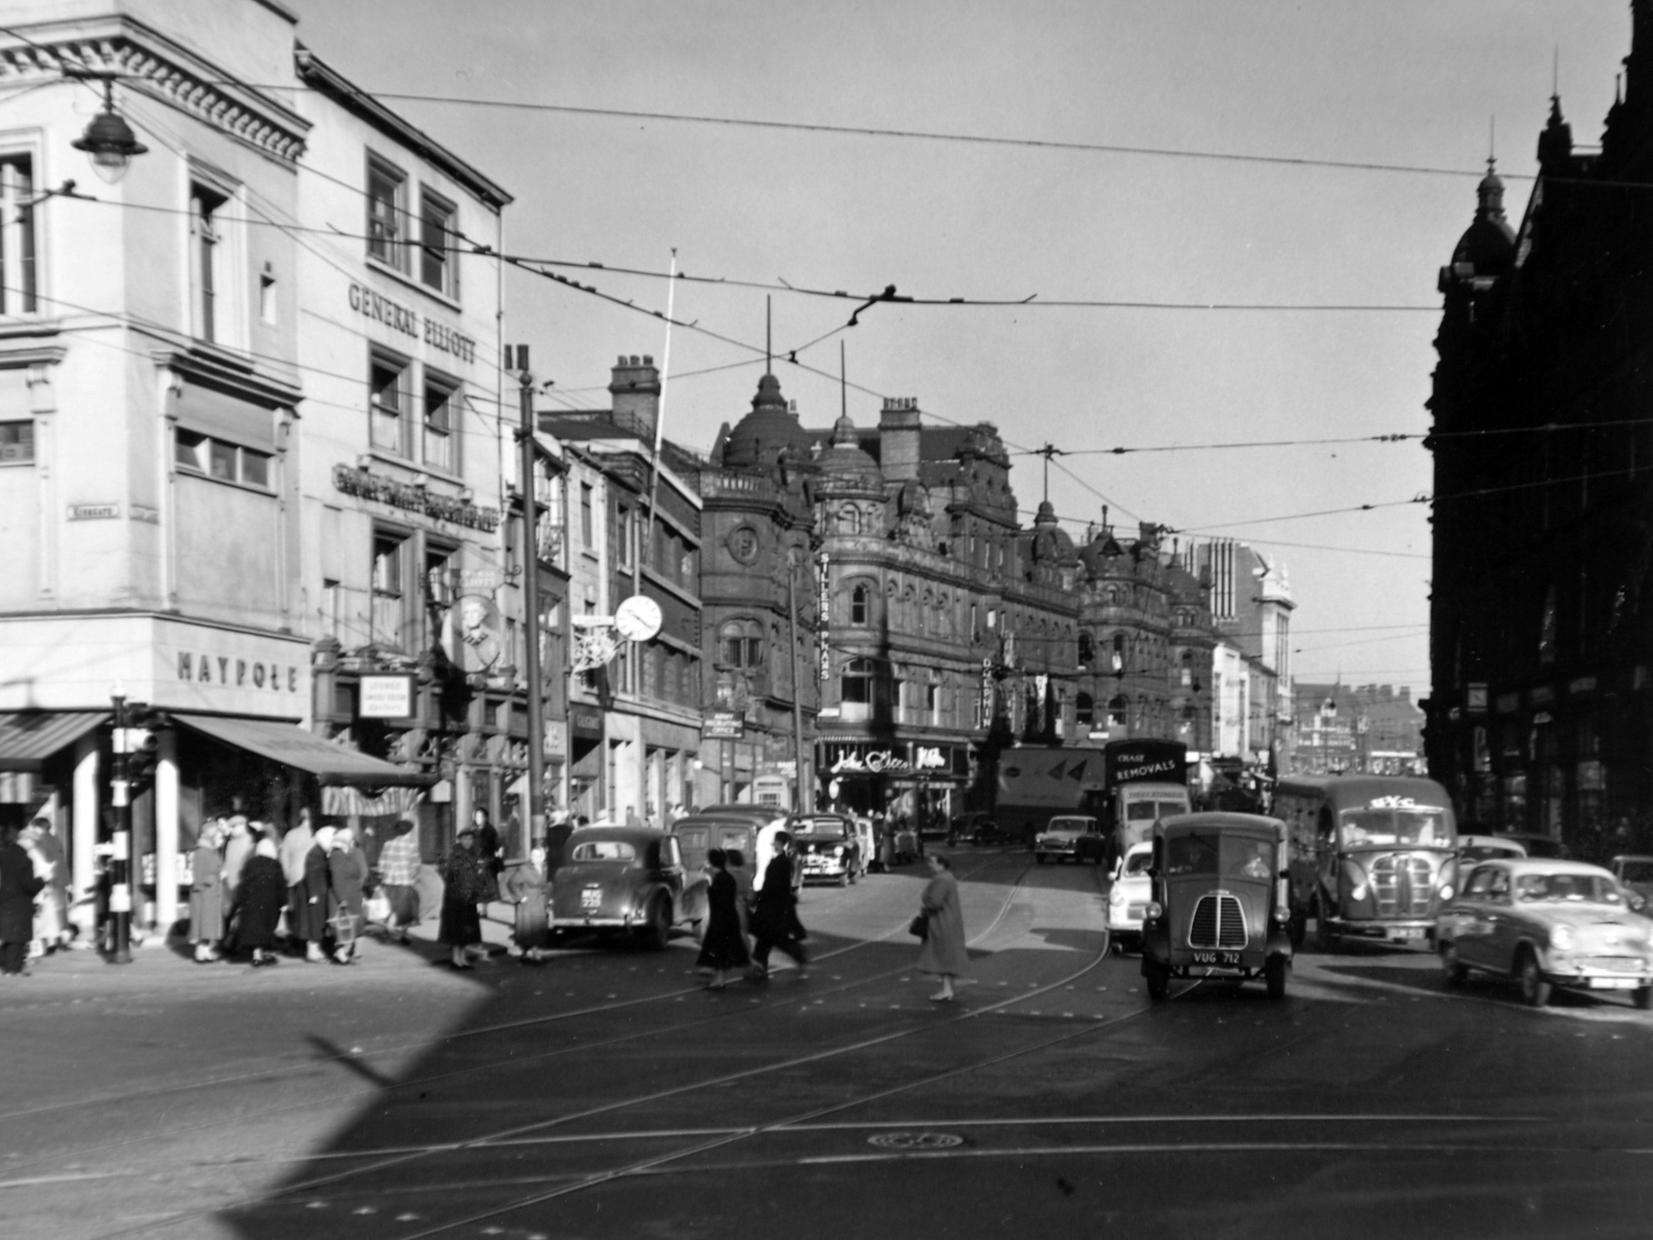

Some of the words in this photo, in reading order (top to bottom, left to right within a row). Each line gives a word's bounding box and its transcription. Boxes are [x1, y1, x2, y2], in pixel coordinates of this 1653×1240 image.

[348, 283, 418, 339] GENERAL
[424, 316, 476, 364] ELLIOTT
[177, 651, 297, 693] MAYPOLE
[1116, 760, 1175, 780] REMOVALS
[1194, 951, 1217, 964] VUG
[1223, 951, 1240, 964] 712
